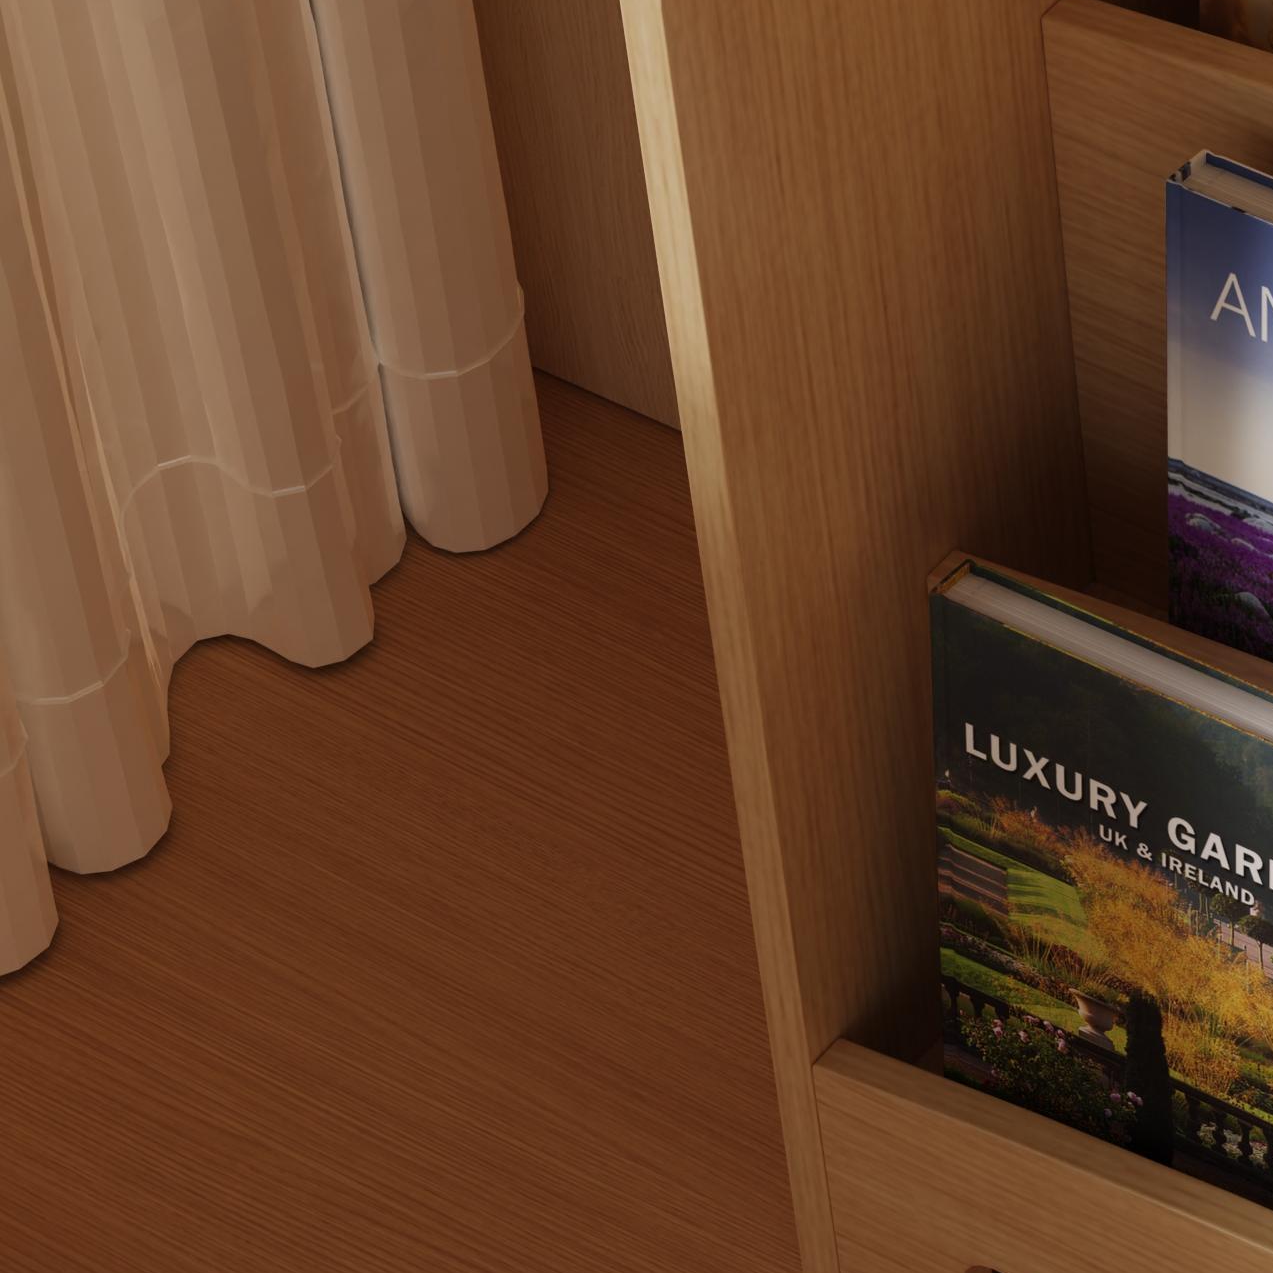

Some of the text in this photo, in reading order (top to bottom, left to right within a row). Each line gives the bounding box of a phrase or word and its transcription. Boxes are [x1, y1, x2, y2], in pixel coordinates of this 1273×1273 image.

[964, 722, 1148, 828] LUXURY
[1099, 824, 1255, 907] UK & IRELAND
